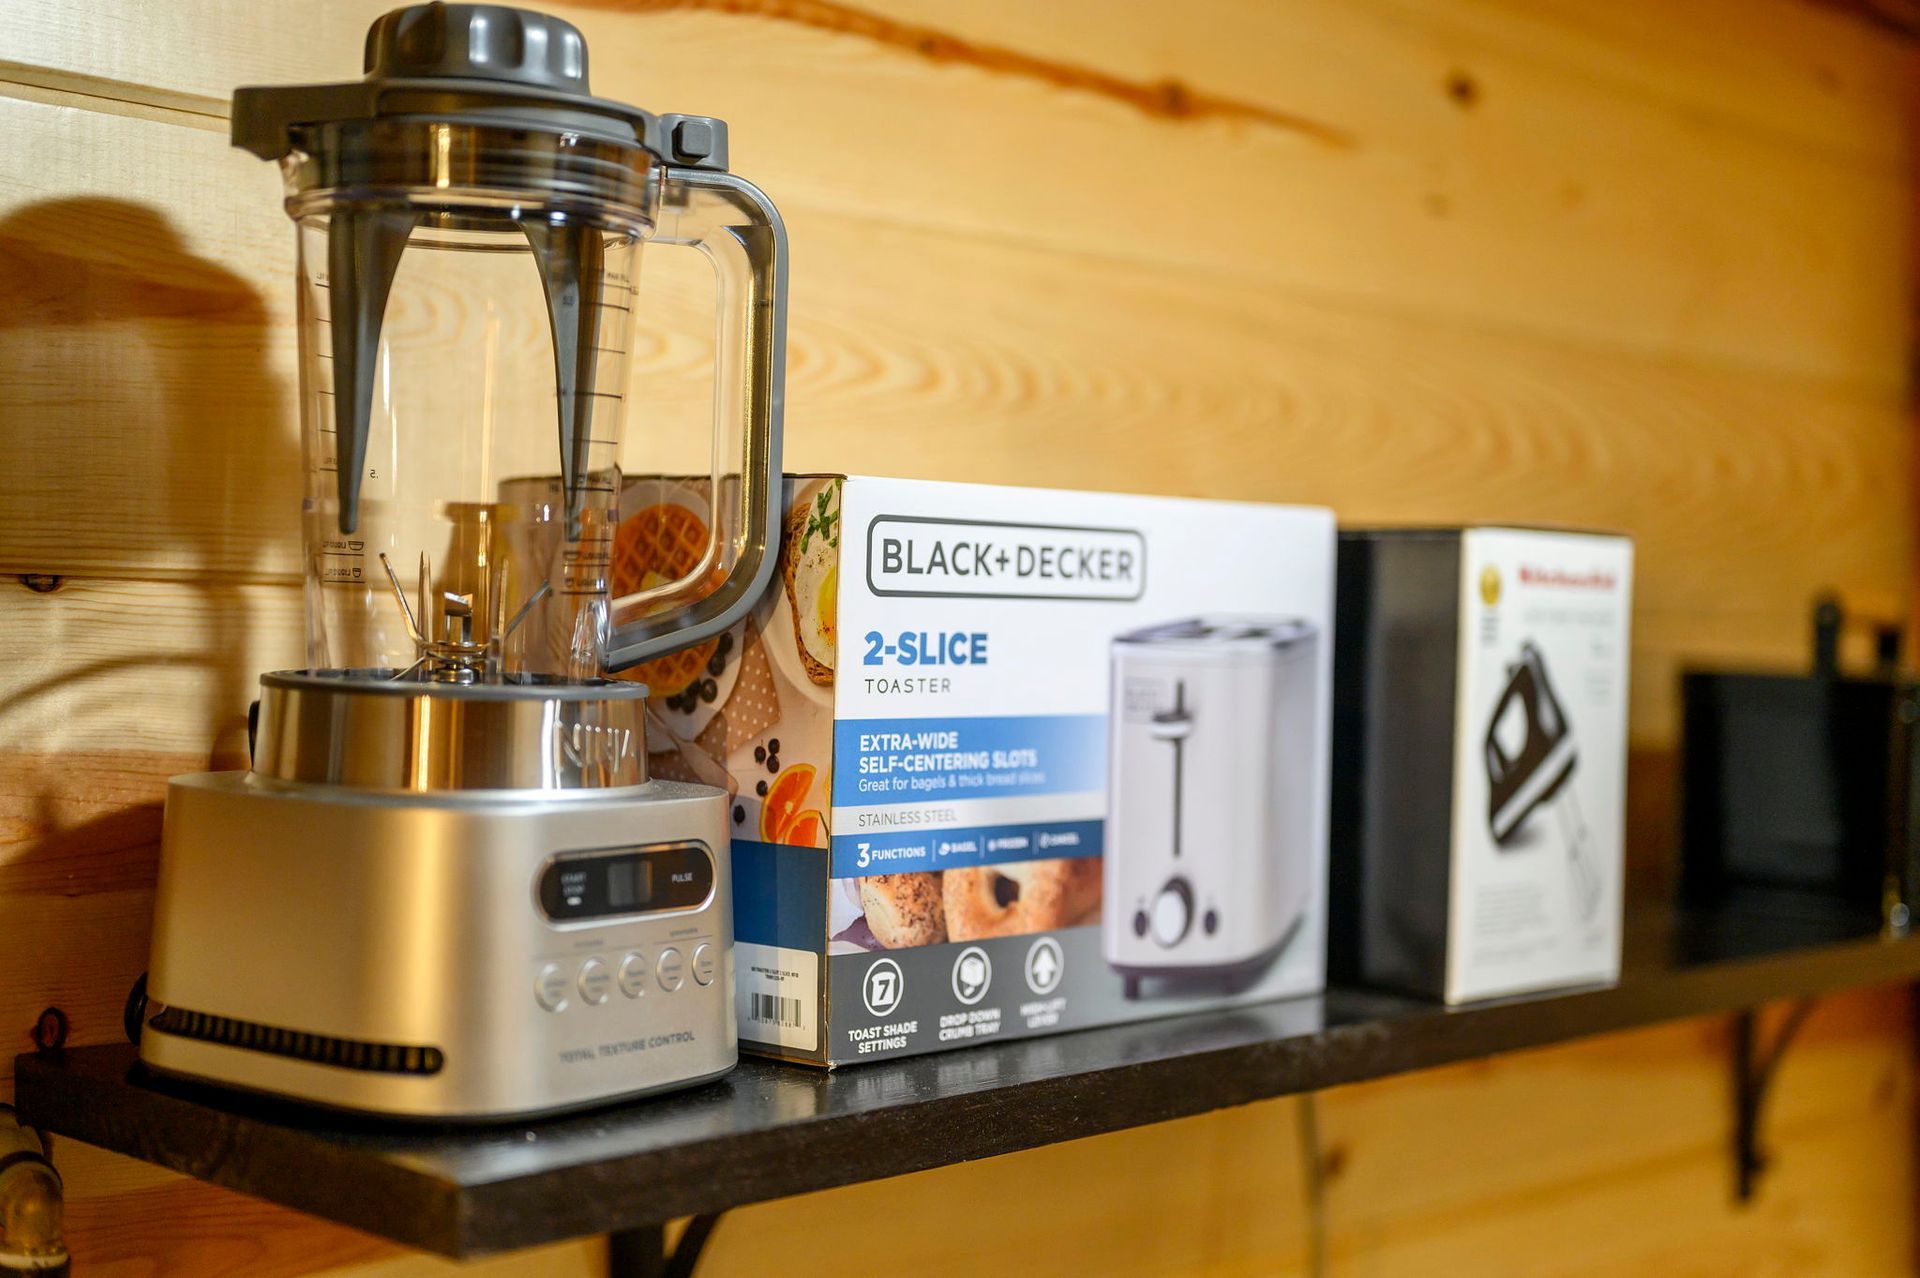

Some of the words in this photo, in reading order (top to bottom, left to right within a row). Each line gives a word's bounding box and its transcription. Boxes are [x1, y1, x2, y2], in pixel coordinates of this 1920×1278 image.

[881, 537, 1134, 581] BLACK+DECKER
[862, 630, 989, 666] 2-SLICE
[864, 677, 951, 694] TOASTER
[859, 731, 959, 752] EXTRA-WIDE
[858, 750, 990, 774] SELF-CENTERING
[991, 748, 1039, 770] SLOTS
[858, 776, 890, 793] Great
[892, 775, 909, 791] for
[911, 774, 946, 793] bagels
[947, 774, 958, 789] &
[958, 772, 984, 788] thick
[858, 810, 921, 828] STAINLESS
[923, 808, 958, 823] STEEL
[856, 842, 871, 868] 3
[871, 846, 927, 861] FUNCTIONS
[671, 873, 693, 883] PULSE
[877, 979, 890, 1001] 7
[647, 1031, 696, 1049] CONTROL
[848, 1026, 881, 1042] TOAST
[883, 1020, 918, 1036] SHADE
[858, 1036, 907, 1054] SETTINGS
